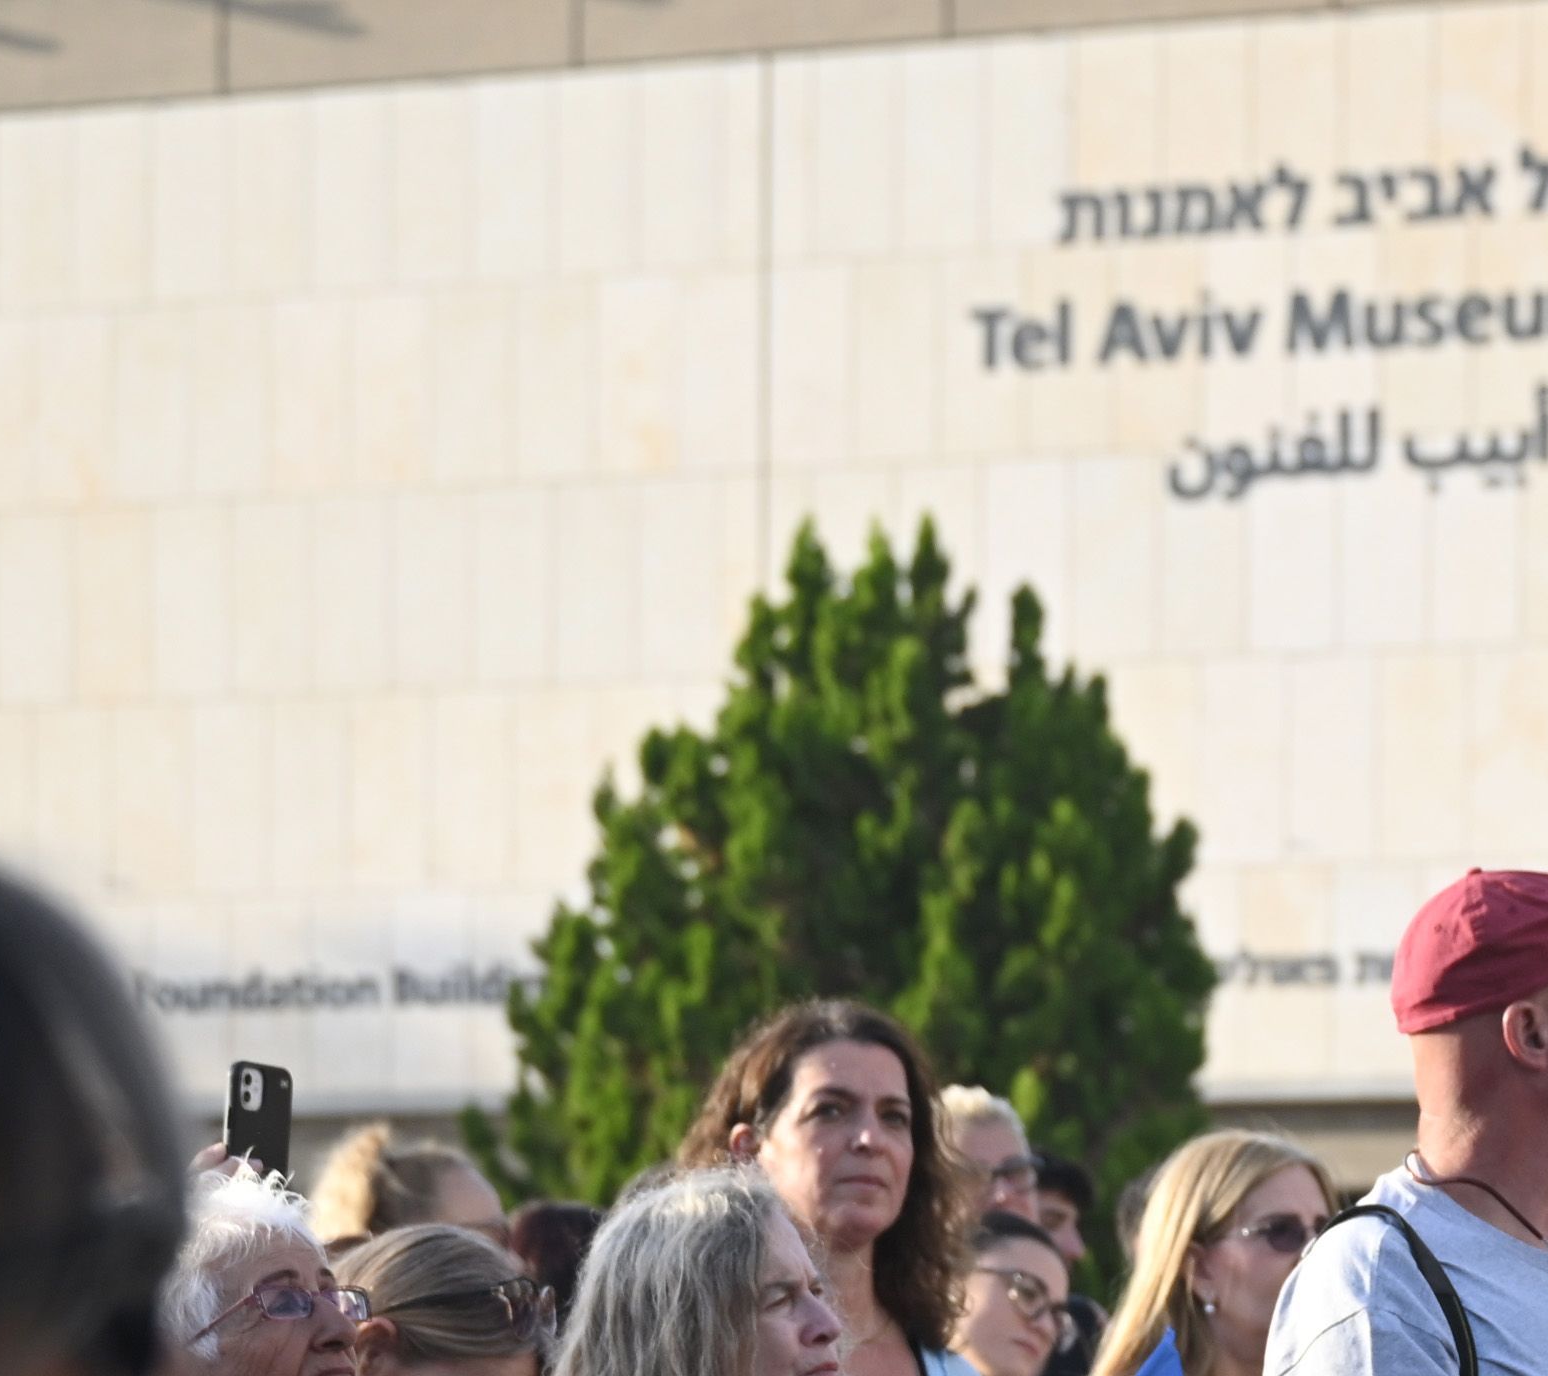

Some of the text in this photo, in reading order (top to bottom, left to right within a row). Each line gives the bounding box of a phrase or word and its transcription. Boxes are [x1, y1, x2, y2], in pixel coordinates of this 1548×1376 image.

[1057, 163, 1310, 245] לאמנות
[1333, 161, 1497, 228] אביב
[971, 301, 1071, 371] Tel
[1097, 290, 1262, 366] Aviv
[1166, 402, 1380, 501] للفنون
